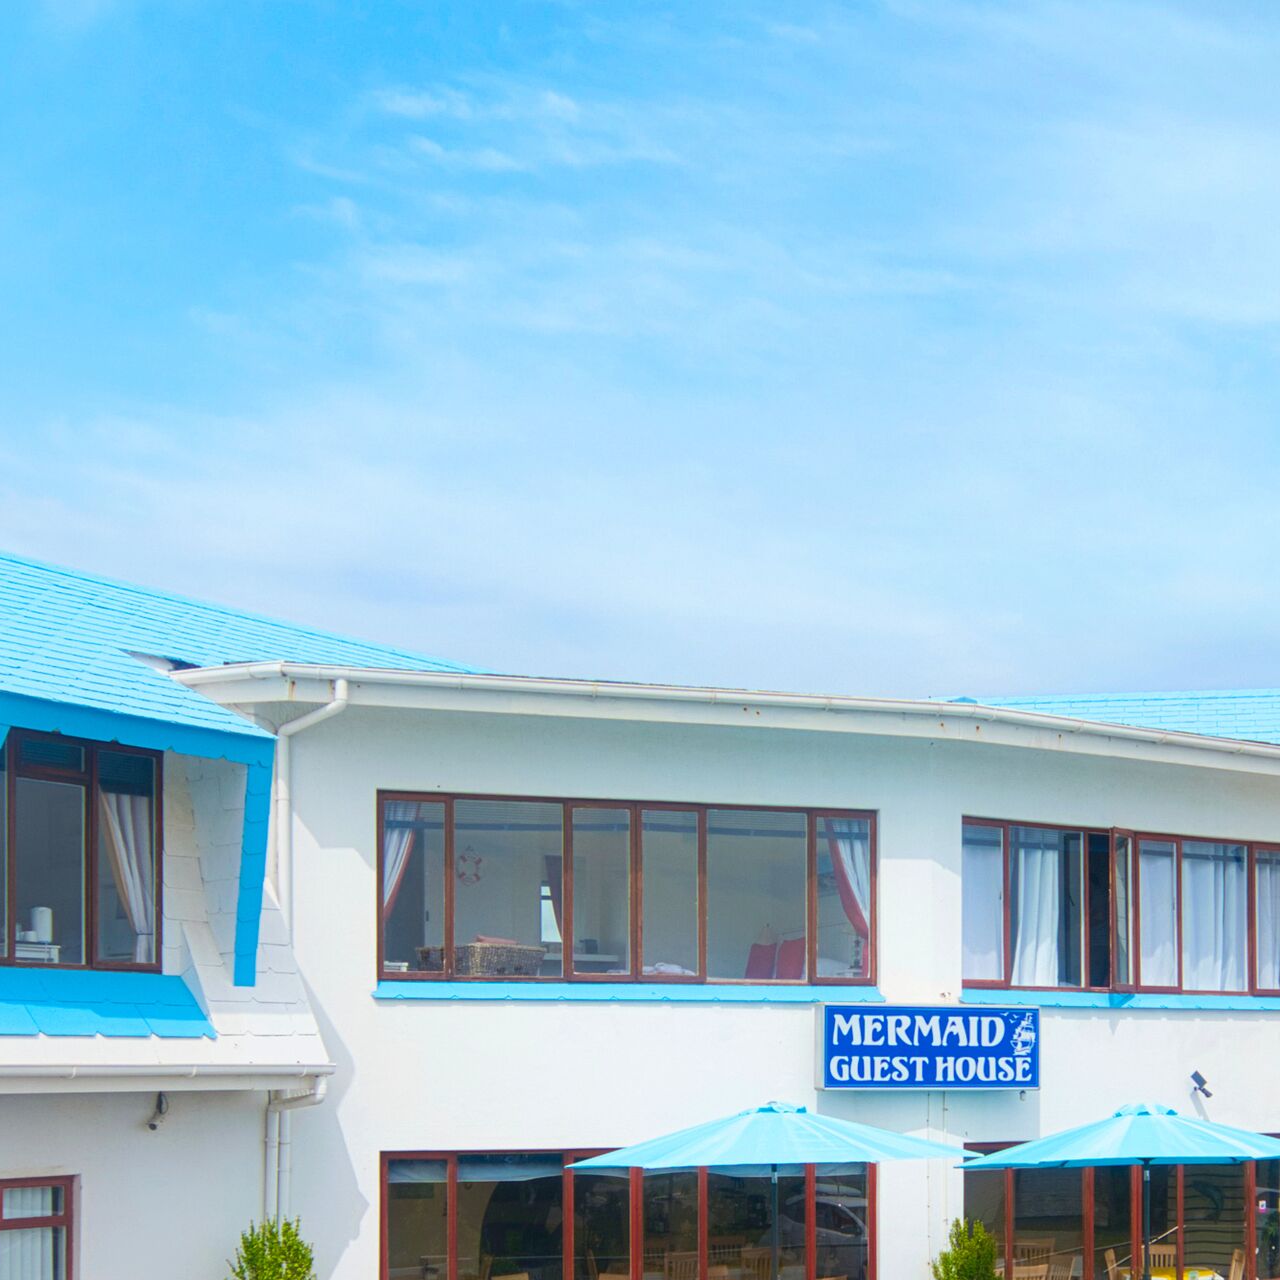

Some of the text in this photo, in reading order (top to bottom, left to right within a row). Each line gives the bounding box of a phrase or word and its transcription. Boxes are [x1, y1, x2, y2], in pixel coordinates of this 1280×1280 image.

[832, 1014, 1005, 1047] MERMAID
[829, 1055, 1032, 1082] GUEST HOUSE
